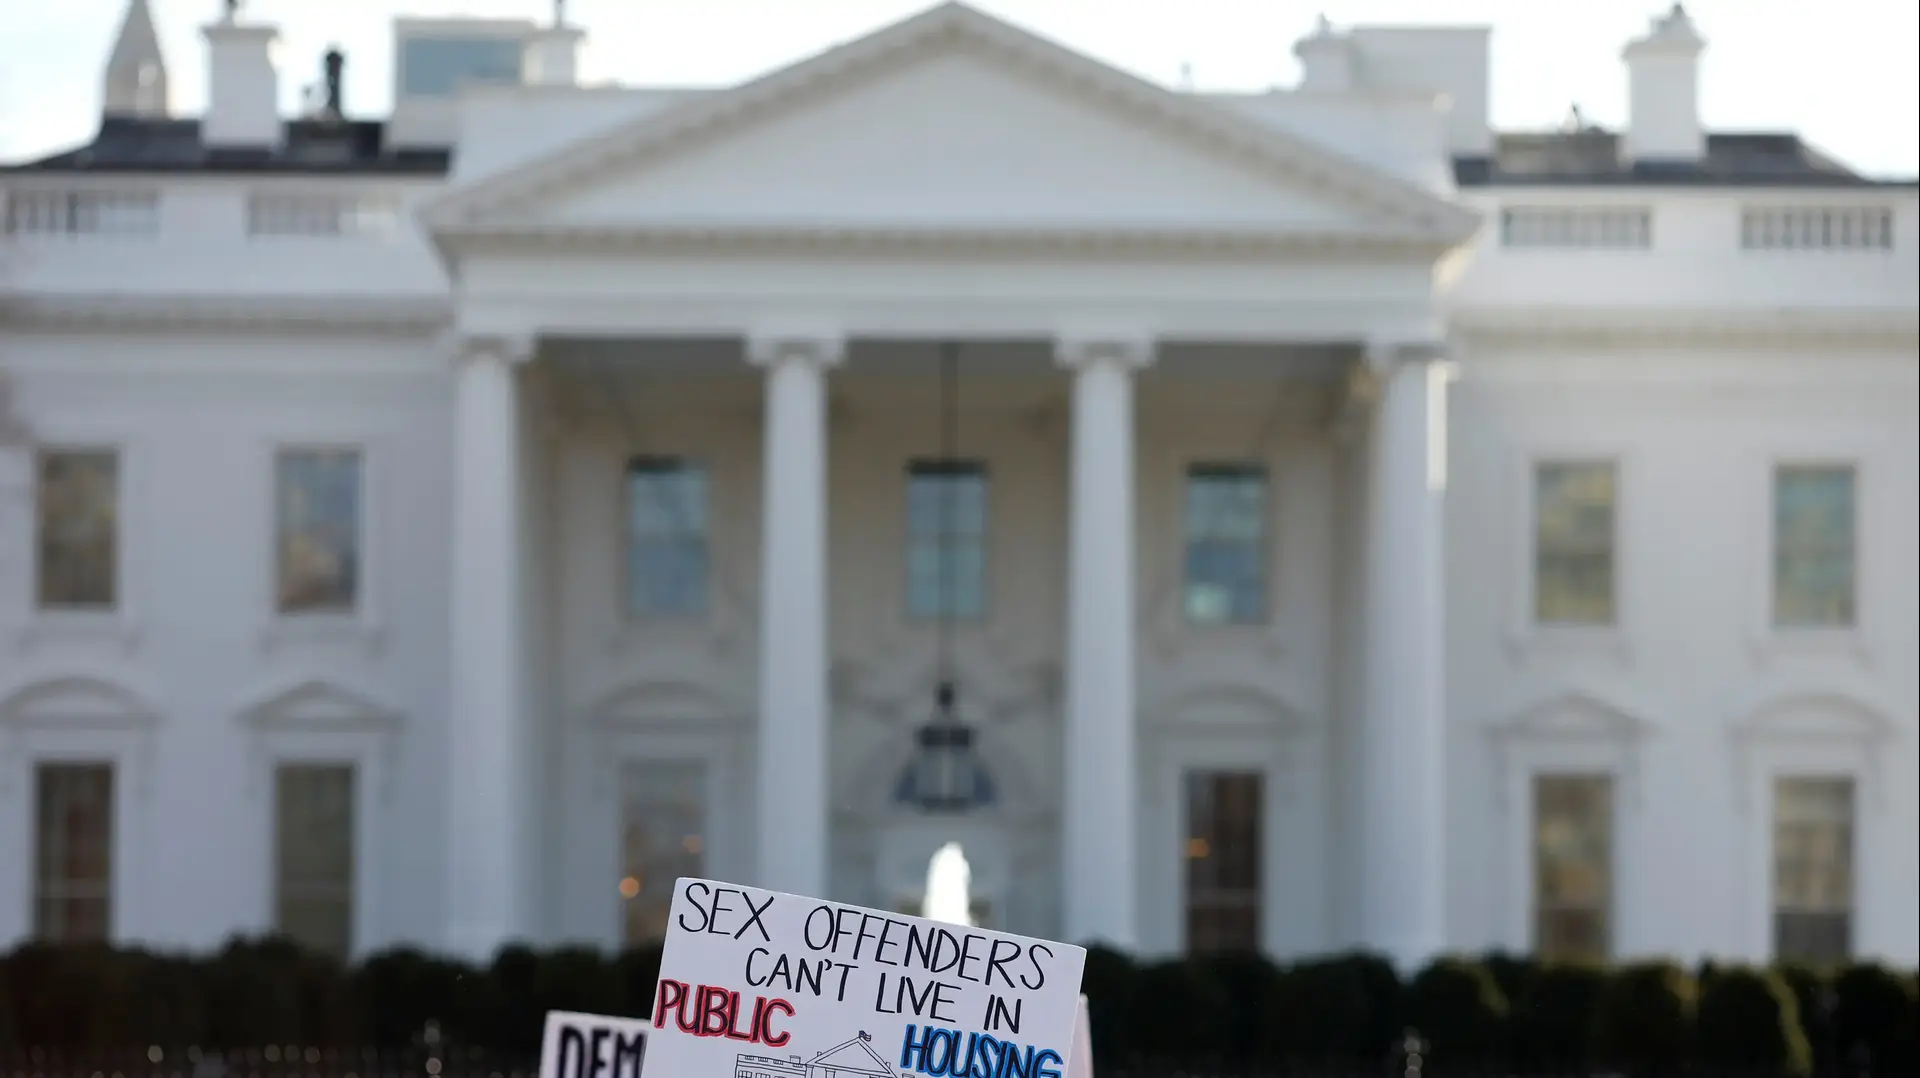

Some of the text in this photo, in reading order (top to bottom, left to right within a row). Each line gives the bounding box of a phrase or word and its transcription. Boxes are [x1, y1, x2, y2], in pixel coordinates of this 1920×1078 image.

[678, 882, 1054, 990] SEX OFFENDERS
[654, 979, 1064, 1078] PUBLIC HOUSING
[745, 947, 1022, 1034] CAN'T LIVE IN
